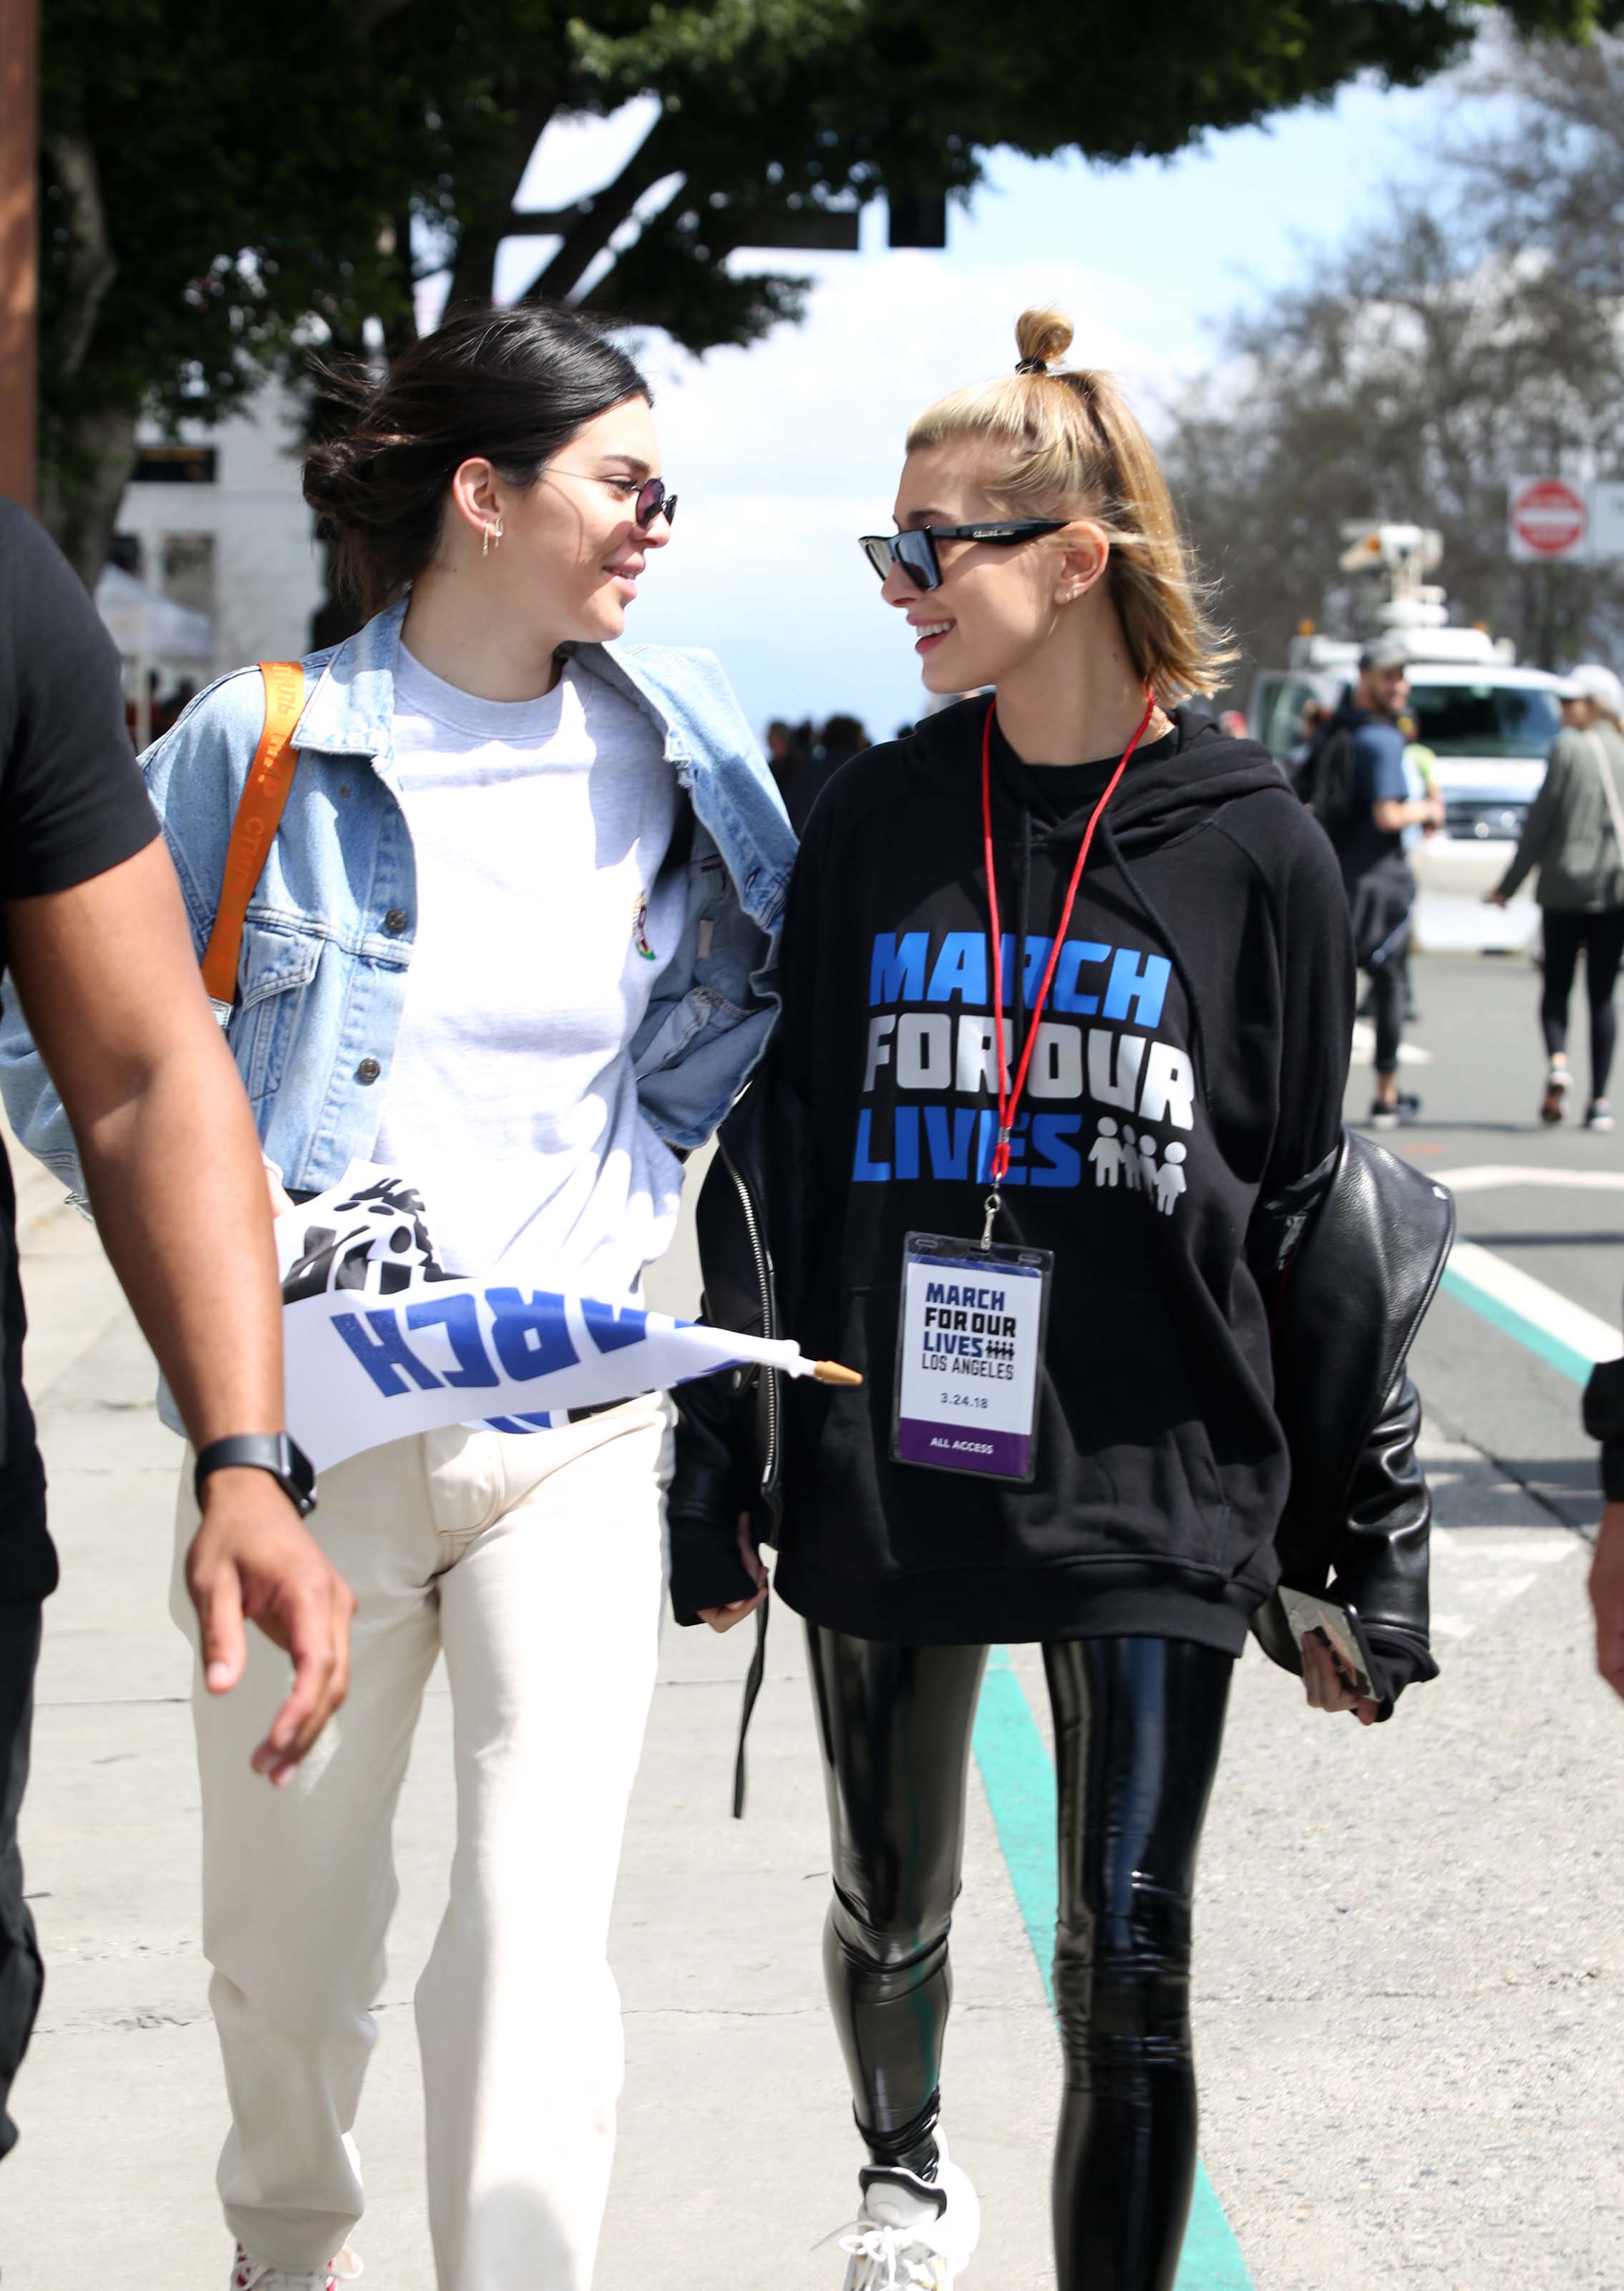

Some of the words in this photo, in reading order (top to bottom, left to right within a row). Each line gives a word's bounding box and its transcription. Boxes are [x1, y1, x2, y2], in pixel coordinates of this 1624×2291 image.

[869, 931, 1172, 1029] MARCH
[862, 1012, 1013, 1095] FOR
[1026, 1022, 1195, 1131] OUR
[852, 1105, 1082, 1188] LIVES
[925, 1282, 1006, 1312] MARCH
[925, 1307, 967, 1332] FOR
[972, 1312, 1016, 1338] OUR
[331, 1287, 701, 1398] ARCH
[923, 1330, 983, 1358] LIVES
[922, 1353, 947, 1372] LOS
[951, 1357, 1014, 1381] ANGELES
[940, 1392, 988, 1409] 3.24.18
[930, 1437, 950, 1449] ALL
[952, 1440, 994, 1455] ACCESS
